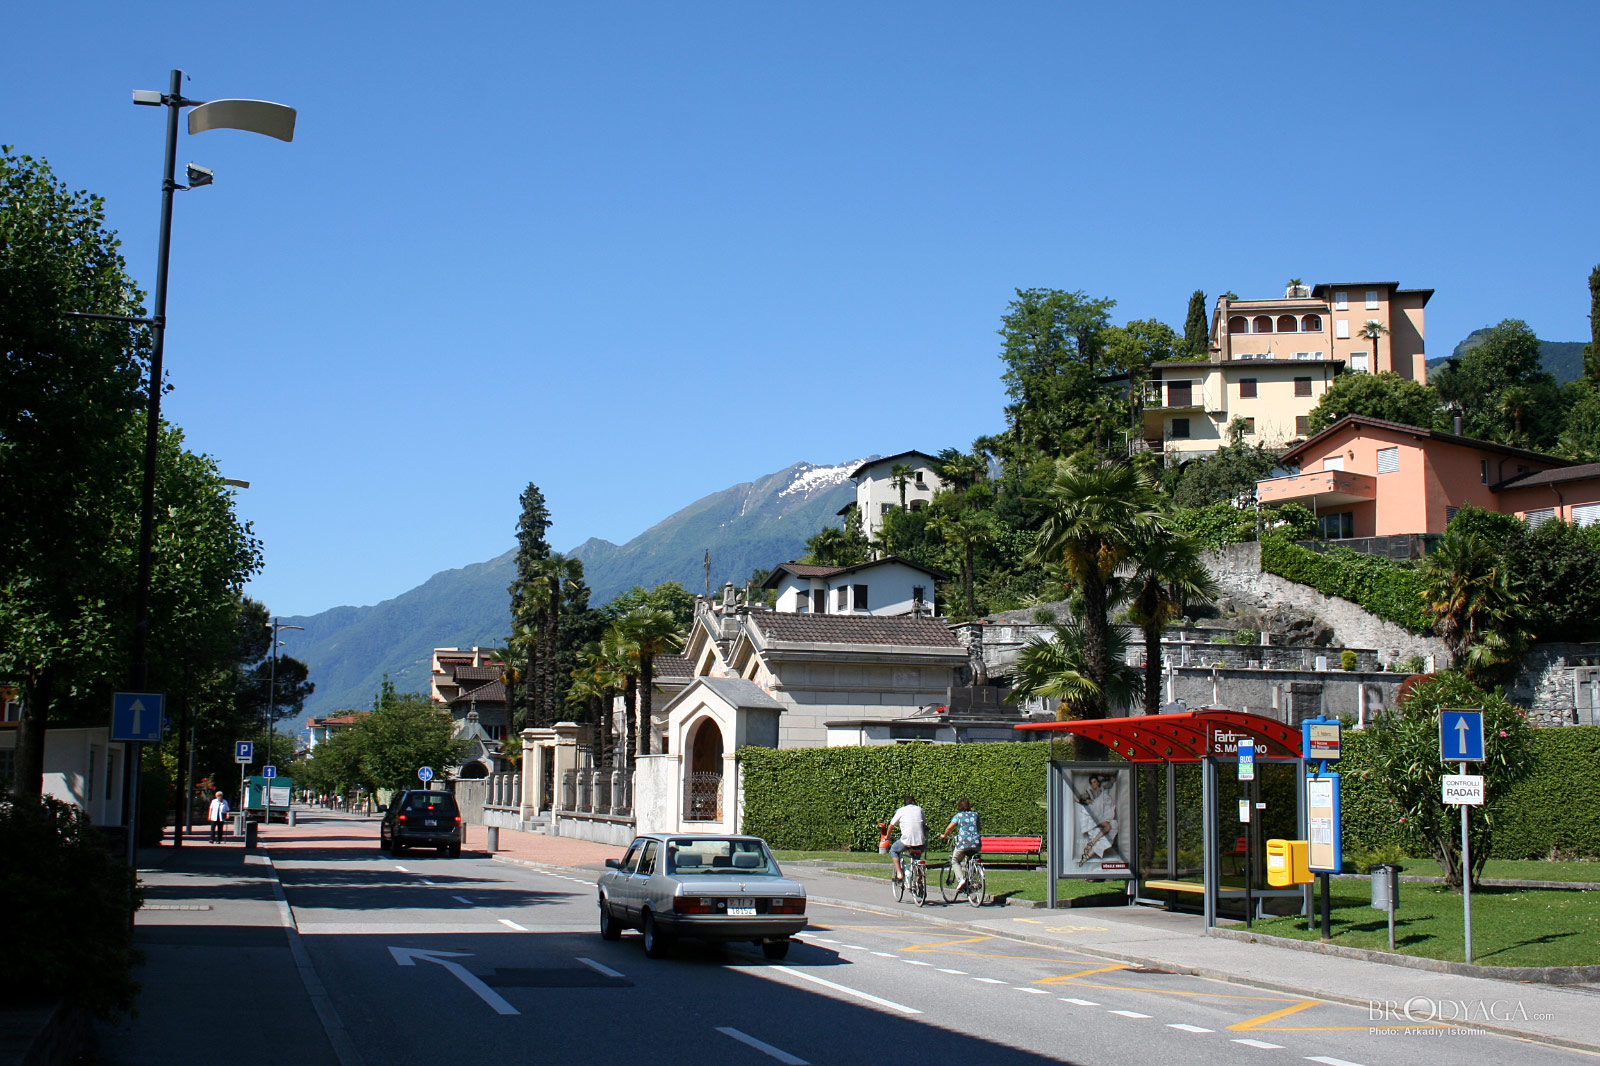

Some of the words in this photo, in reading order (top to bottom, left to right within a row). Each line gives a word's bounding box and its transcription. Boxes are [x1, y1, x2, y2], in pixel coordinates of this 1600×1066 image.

[1214, 729, 1235, 742] Fart
[240, 744, 248, 756] P
[1214, 744, 1223, 753] S.
[1224, 744, 1267, 754] MANO
[1446, 788, 1480, 797] RADAR
